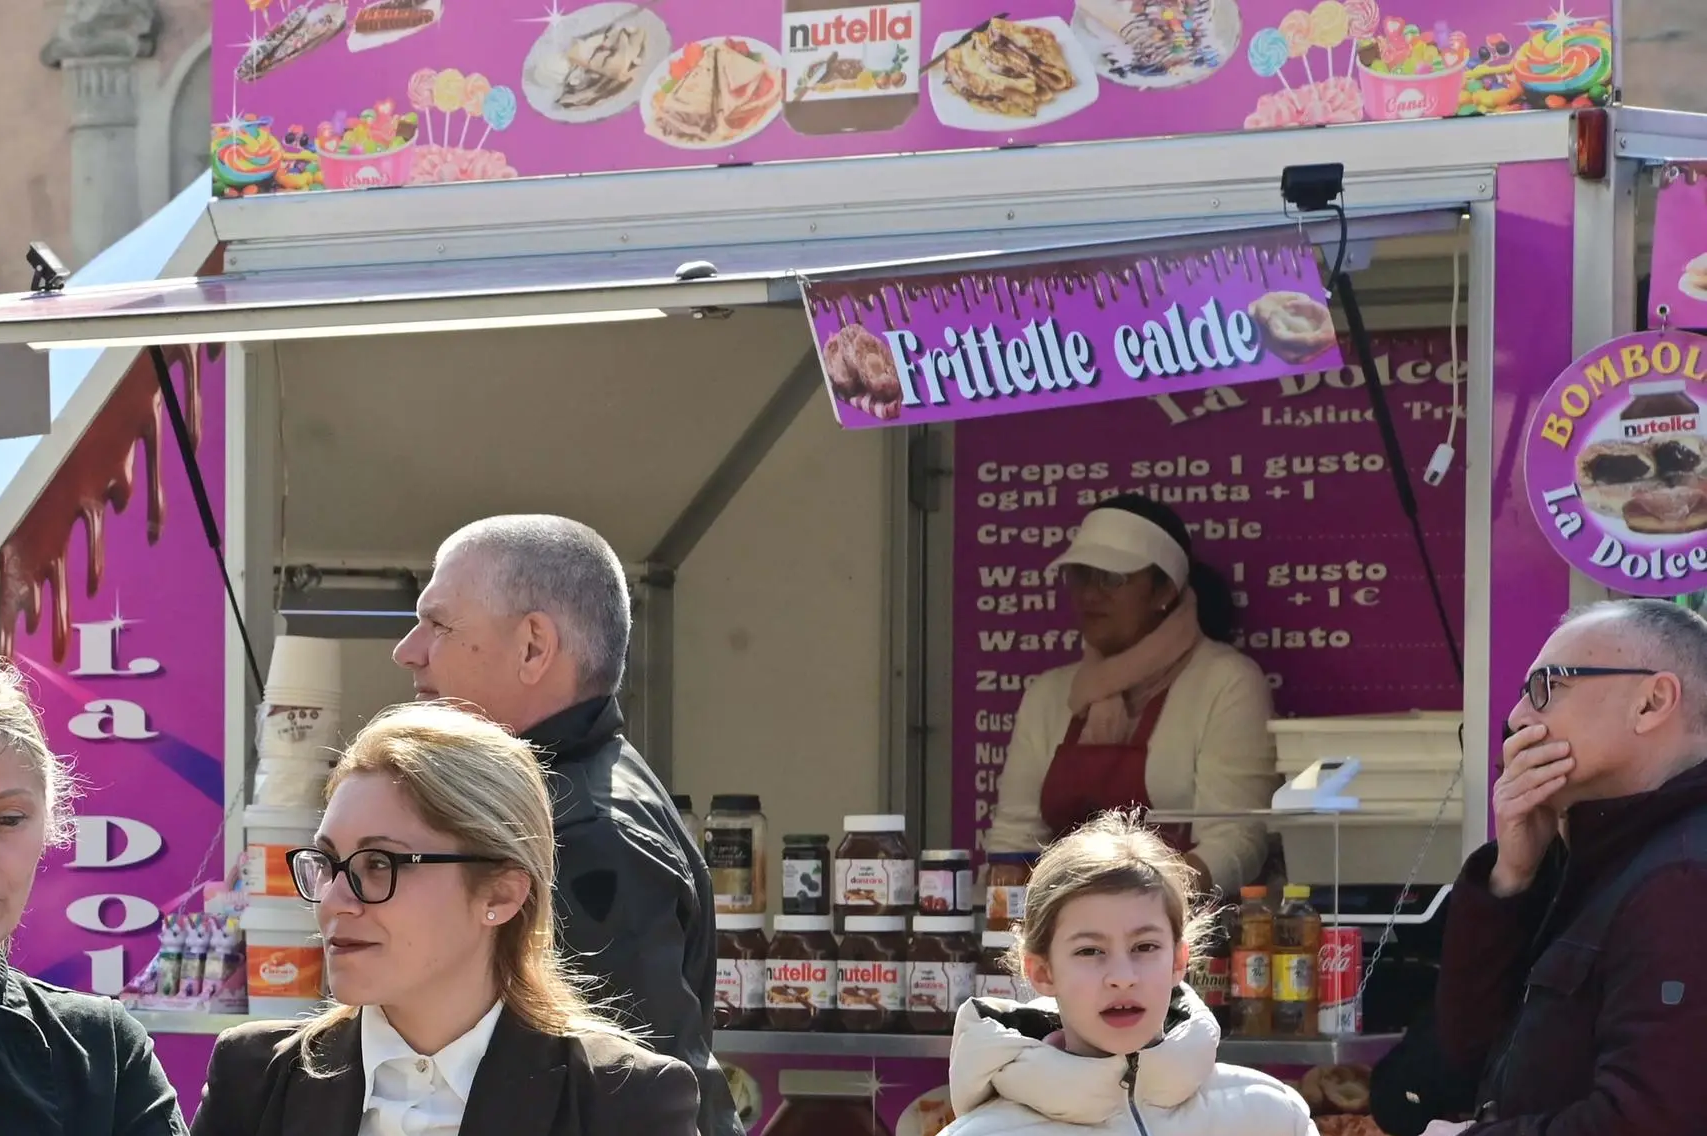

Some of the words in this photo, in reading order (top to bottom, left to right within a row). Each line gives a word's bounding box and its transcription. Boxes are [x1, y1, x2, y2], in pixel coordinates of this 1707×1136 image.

[789, 8, 912, 48] nutella
[882, 316, 1097, 407] Frittelle
[1113, 295, 1261, 380] calde
[1623, 415, 1697, 438] nutella
[977, 461, 1110, 485] Crepes
[1130, 456, 1210, 478] solo
[1230, 454, 1243, 475] 1
[1264, 451, 1384, 478] gusto
[977, 486, 1057, 512] ogni
[1543, 482, 1582, 541] La
[1232, 562, 1244, 582] 1
[1267, 560, 1387, 586] gusto
[976, 591, 1057, 615] ogni
[67, 621, 161, 740] La
[766, 962, 827, 982] nutella
[837, 963, 898, 983] nutella
